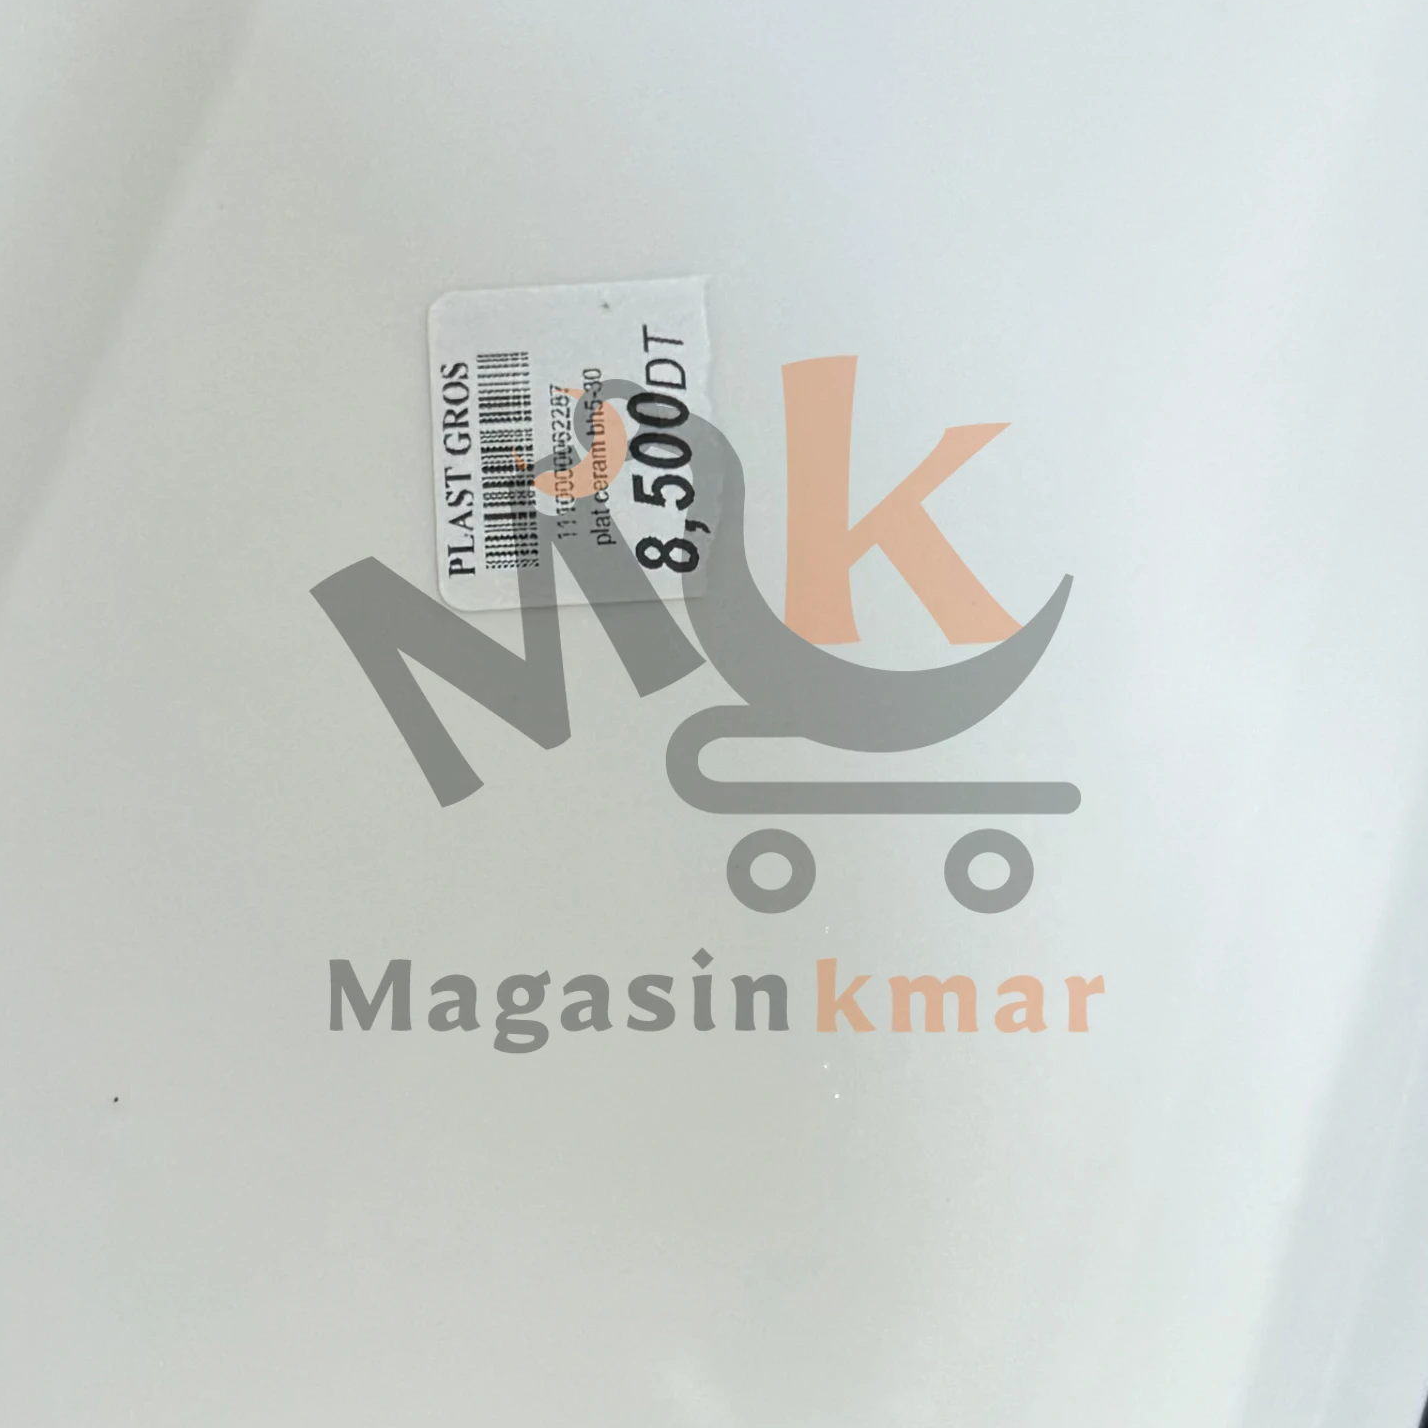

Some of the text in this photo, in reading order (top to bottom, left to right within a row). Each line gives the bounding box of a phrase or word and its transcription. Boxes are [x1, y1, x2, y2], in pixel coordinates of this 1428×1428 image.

[440, 360, 478, 578] PLAST GROS
[581, 368, 616, 546] plat ceram bh5-30
[624, 323, 711, 574] 8,500DT
